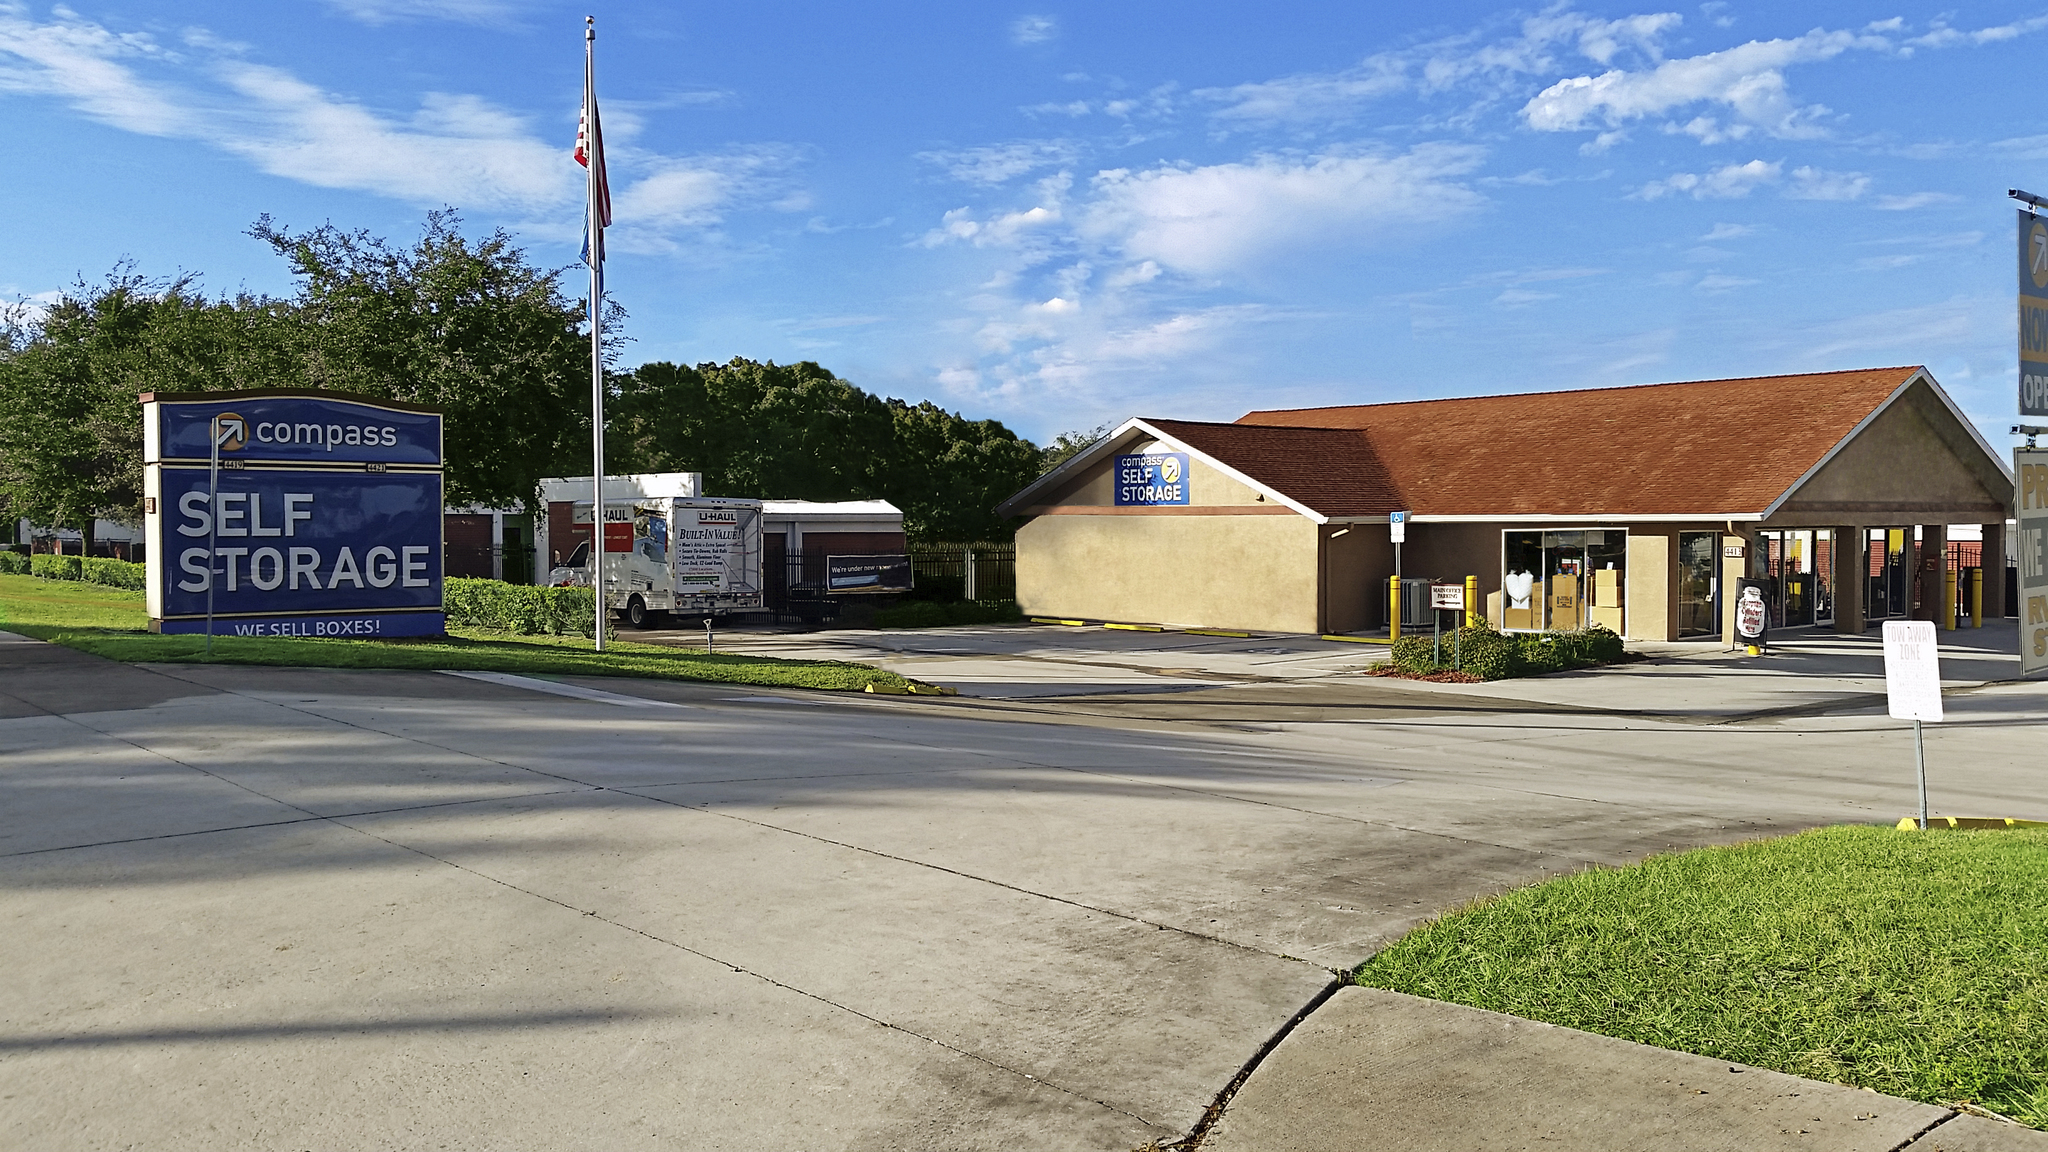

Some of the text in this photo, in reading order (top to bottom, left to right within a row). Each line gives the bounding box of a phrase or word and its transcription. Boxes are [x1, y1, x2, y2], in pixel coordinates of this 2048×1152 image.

[256, 422, 397, 451] compass
[1122, 456, 1163, 468] compass
[1122, 468, 1153, 484] SELF
[1122, 485, 1182, 501] STORAGE
[177, 491, 313, 537] SELF
[699, 512, 736, 521] U-HAUL
[2023, 528, 2043, 578] WE
[177, 545, 430, 592] STORAGE
[831, 566, 847, 574] We're
[848, 565, 863, 573] under
[235, 620, 380, 637] WE SELL BOXES!
[1886, 626, 1931, 642] TOW AWAY
[1900, 644, 1921, 660] ZONE
